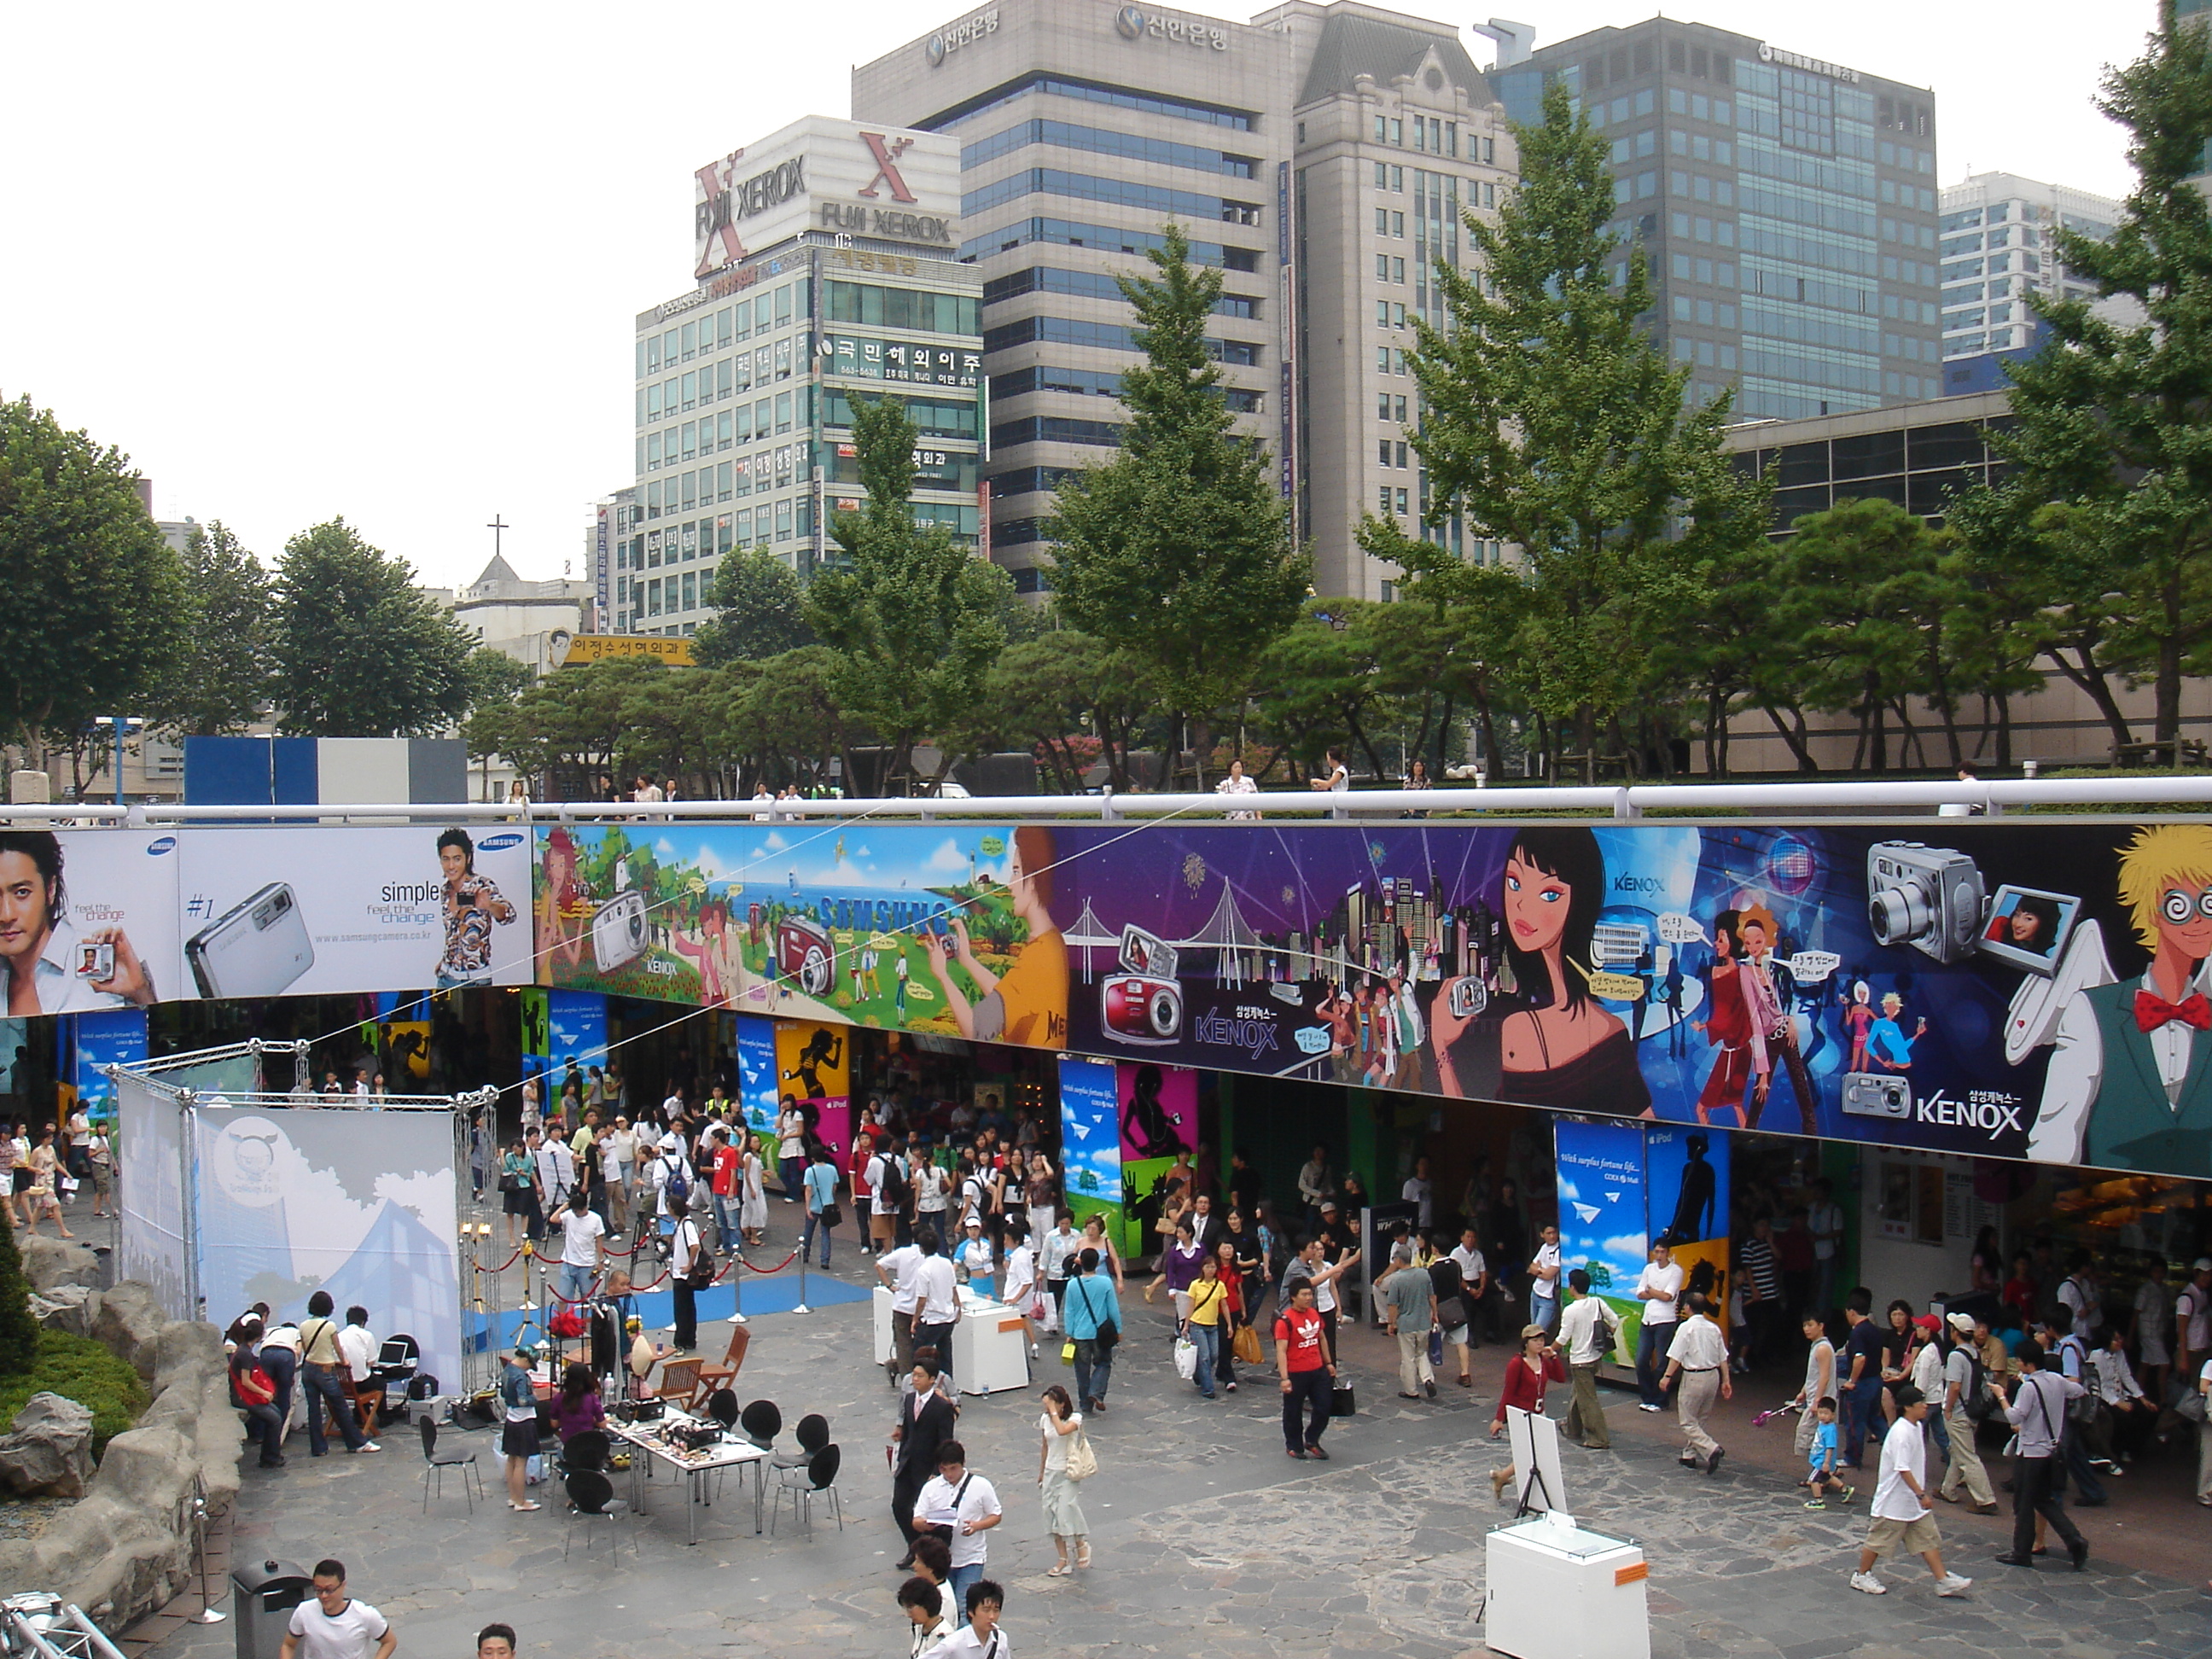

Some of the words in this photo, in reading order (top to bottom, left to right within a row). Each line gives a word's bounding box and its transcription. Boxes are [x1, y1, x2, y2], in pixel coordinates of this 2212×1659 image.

[943, 9, 999, 53] 신한은행
[1148, 15, 1228, 51] 신한은행
[696, 189, 731, 240] FUJI
[736, 154, 806, 221] XEROX
[823, 202, 866, 231] FUJI
[873, 209, 952, 242] XEROX
[938, 374, 956, 386] 이민
[482, 838, 520, 847] SAMSUNG
[381, 881, 439, 905] simple
[1614, 872, 1665, 898] KENOX
[75, 904, 94, 912] feel
[95, 903, 110, 911] the
[86, 910, 125, 922] change
[186, 894, 214, 920] #1
[367, 905, 390, 915] feel
[394, 905, 414, 914] the
[381, 911, 434, 925] change
[316, 931, 432, 943] www.samsungcamera.co.kr
[647, 955, 678, 981] KENOX
[1196, 1007, 1278, 1059] KENOX
[832, 1099, 847, 1109] iPod
[1969, 1090, 2013, 1103] 삼성케녹스
[1917, 1089, 2023, 1140] KENOX
[1656, 1133, 1672, 1144] iPod
[1561, 1153, 1577, 1164] With
[1577, 1155, 1599, 1169] surplus
[1599, 1159, 1623, 1171] fortune
